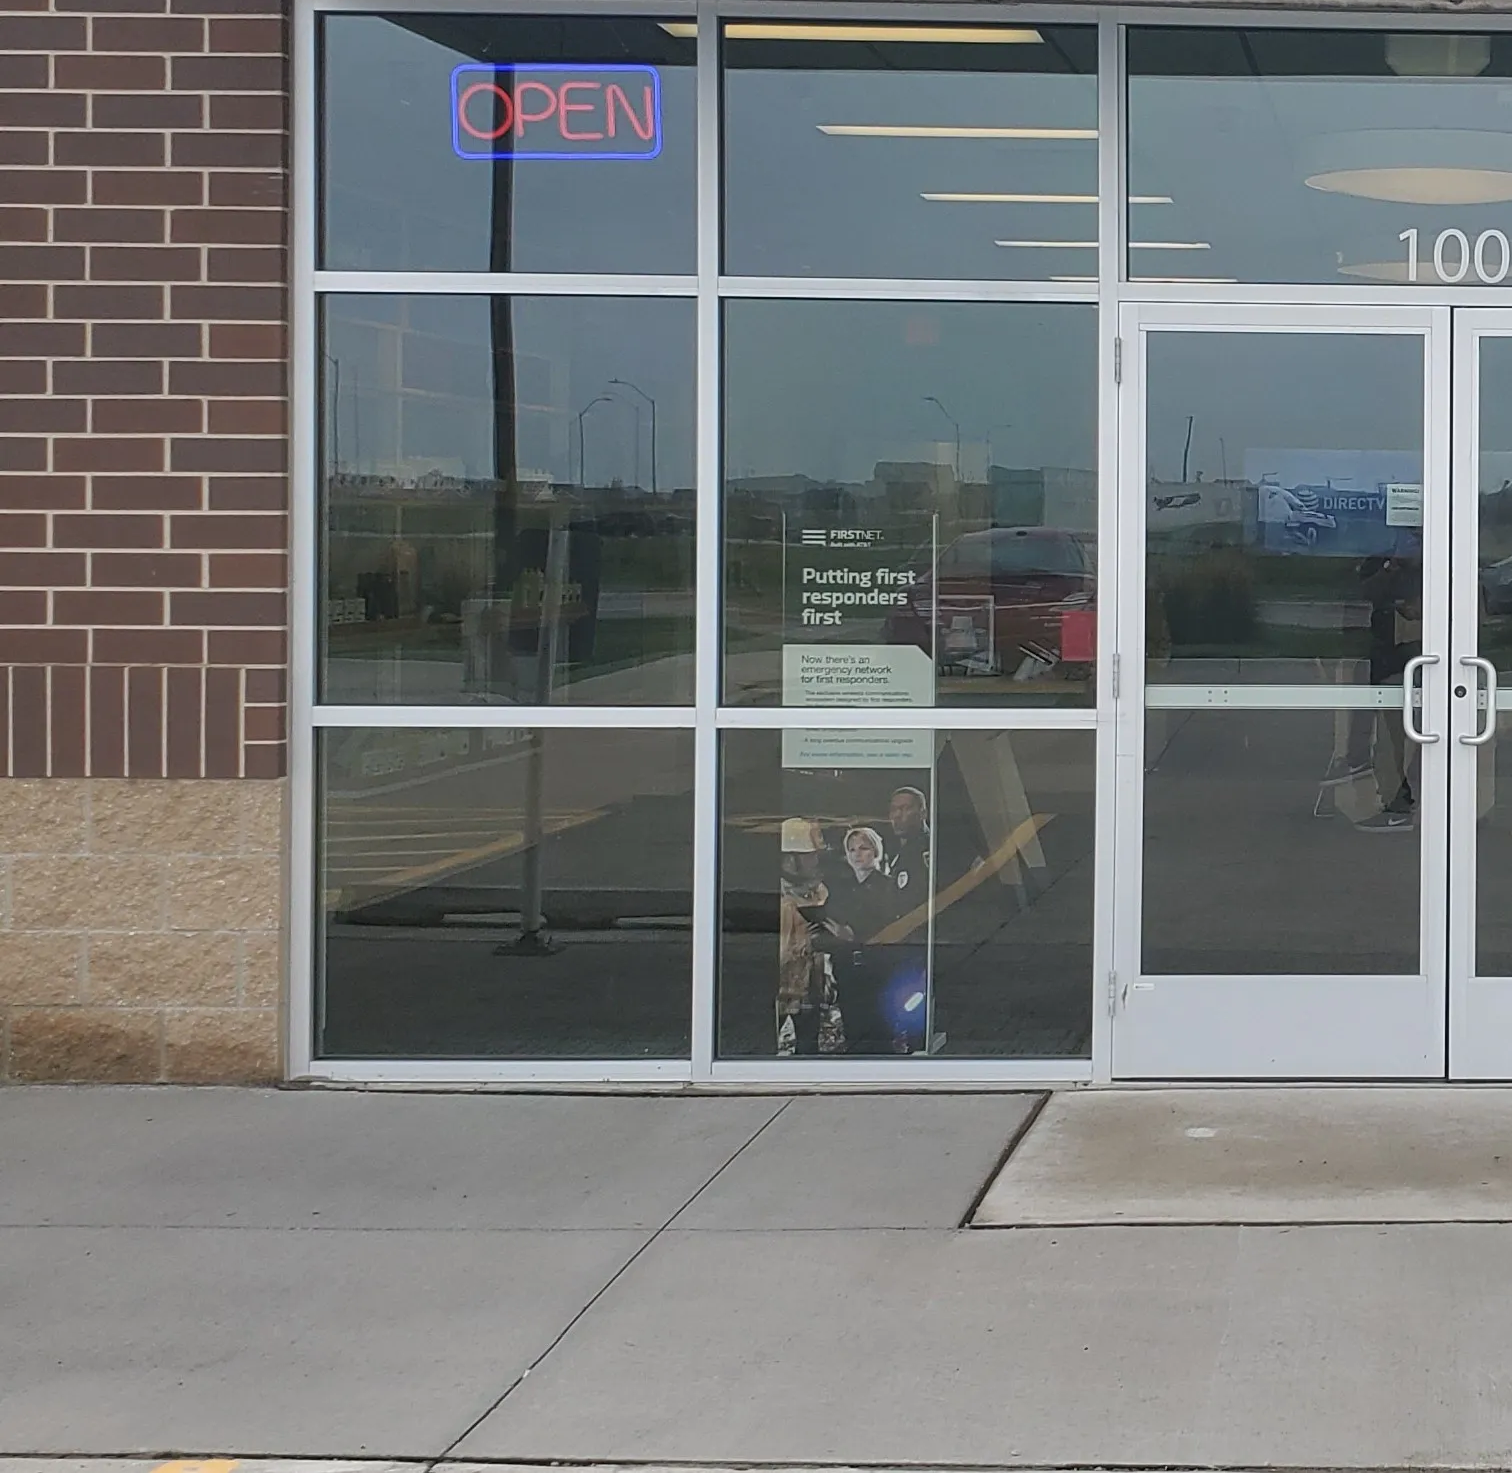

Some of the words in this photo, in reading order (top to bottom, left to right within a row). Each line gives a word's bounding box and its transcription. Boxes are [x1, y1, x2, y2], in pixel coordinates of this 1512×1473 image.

[458, 81, 654, 141] OPEN
[1399, 228, 1511, 284] 100
[1323, 497, 1385, 511] DIRECTV
[802, 568, 872, 587] Putting
[875, 568, 916, 585] first
[802, 589, 908, 608] responders
[802, 608, 843, 625] first
[801, 655, 822, 664] Now
[826, 655, 856, 664] there's
[801, 667, 852, 676] emergency
[855, 665, 892, 674] network
[801, 676, 814, 684] for
[816, 676, 834, 684] first
[836, 676, 890, 685] responders.
